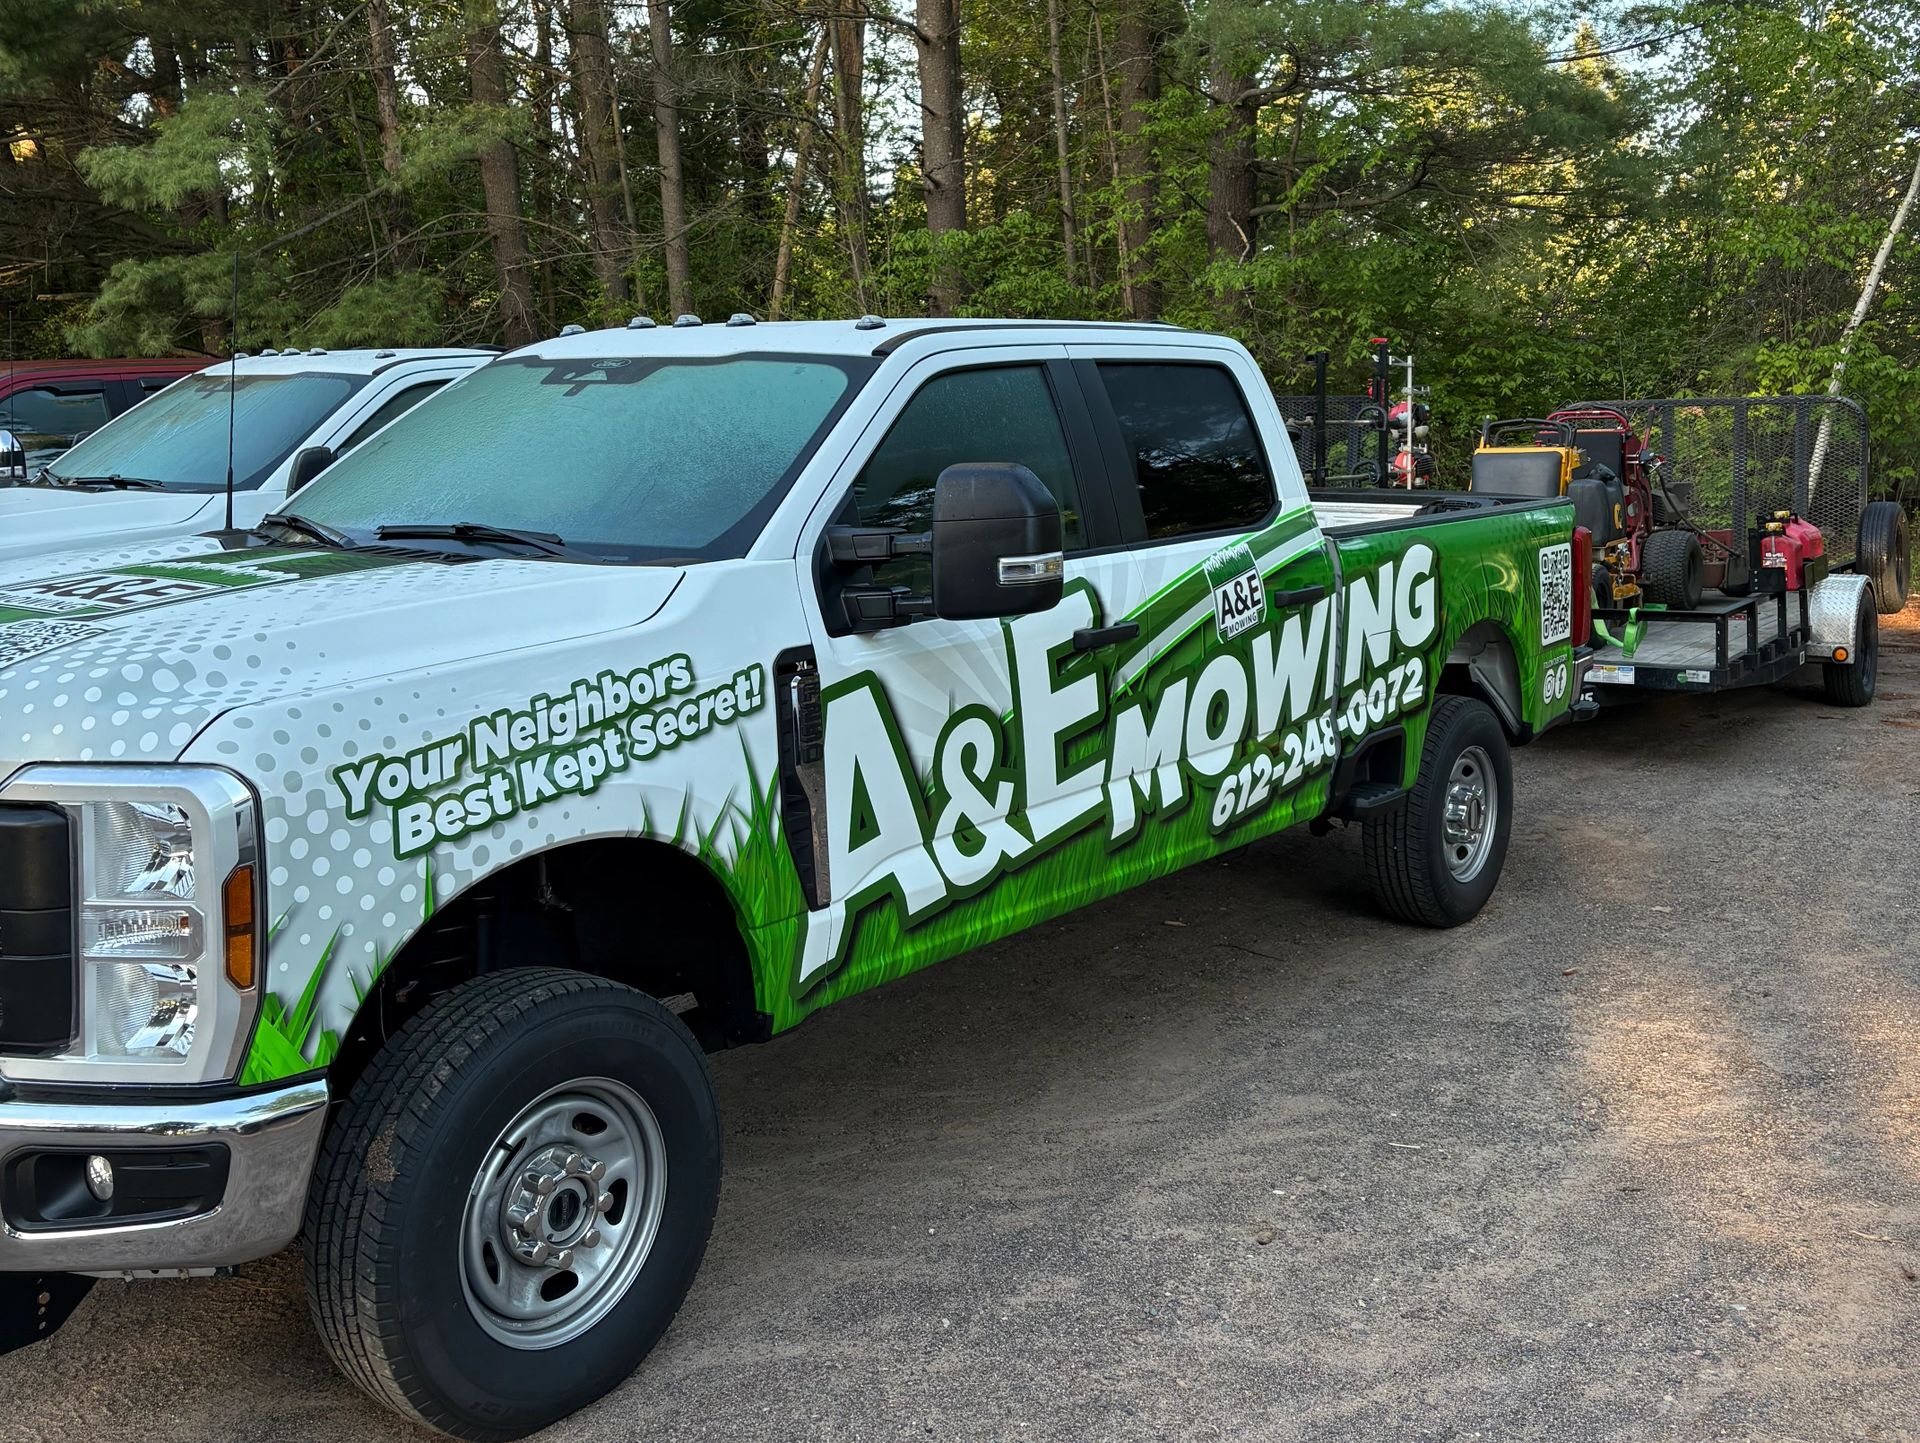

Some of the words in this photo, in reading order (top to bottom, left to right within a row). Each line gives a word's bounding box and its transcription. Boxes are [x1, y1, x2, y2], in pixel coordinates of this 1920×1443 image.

[6, 576, 207, 605] A&E
[1221, 573, 1262, 625] A&E
[1228, 612, 1258, 635] MOWING
[795, 660, 814, 672] XL
[338, 738, 463, 815] Your
[474, 656, 692, 768] Neighbors
[397, 773, 513, 856] Best
[521, 732, 625, 806] Kept
[631, 667, 763, 756] Secret!
[799, 588, 1106, 984] A&E
[1108, 543, 1436, 841] MOWING
[1211, 656, 1425, 828] 612-248-0072
